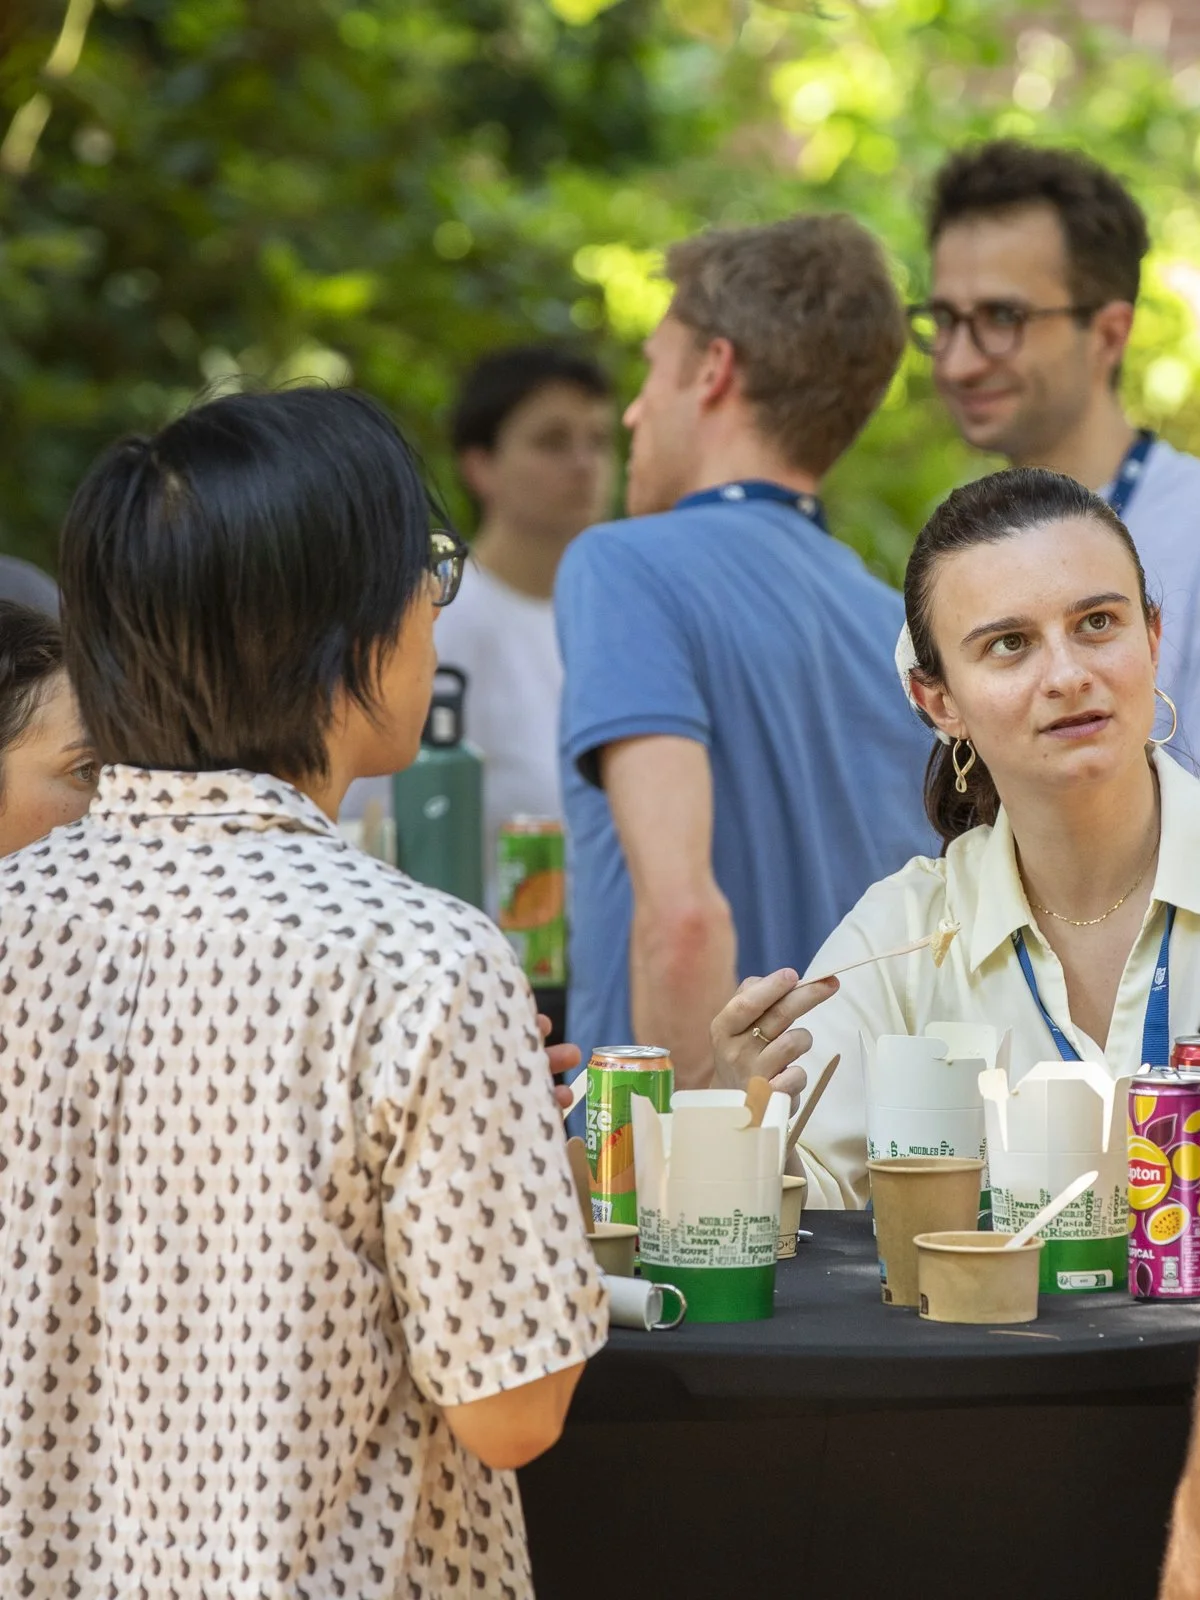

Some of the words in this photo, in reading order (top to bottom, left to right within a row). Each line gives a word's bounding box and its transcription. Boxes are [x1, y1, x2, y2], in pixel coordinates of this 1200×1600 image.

[909, 1145, 939, 1156] NOODLES
[1128, 1166, 1161, 1182] ipton
[1015, 1201, 1040, 1210] PASTA
[1086, 1190, 1094, 1227] SOUPE
[698, 1216, 732, 1226] NOODLES
[749, 1216, 771, 1224] PASTA
[1056, 1218, 1085, 1227] Pasta
[687, 1225, 729, 1236] Risotto
[731, 1209, 743, 1243] Soup
[1049, 1228, 1092, 1238] Risotto
[680, 1248, 708, 1256] SOUPE
[748, 1244, 773, 1254] SOUPE
[673, 1255, 706, 1266] Risotto
